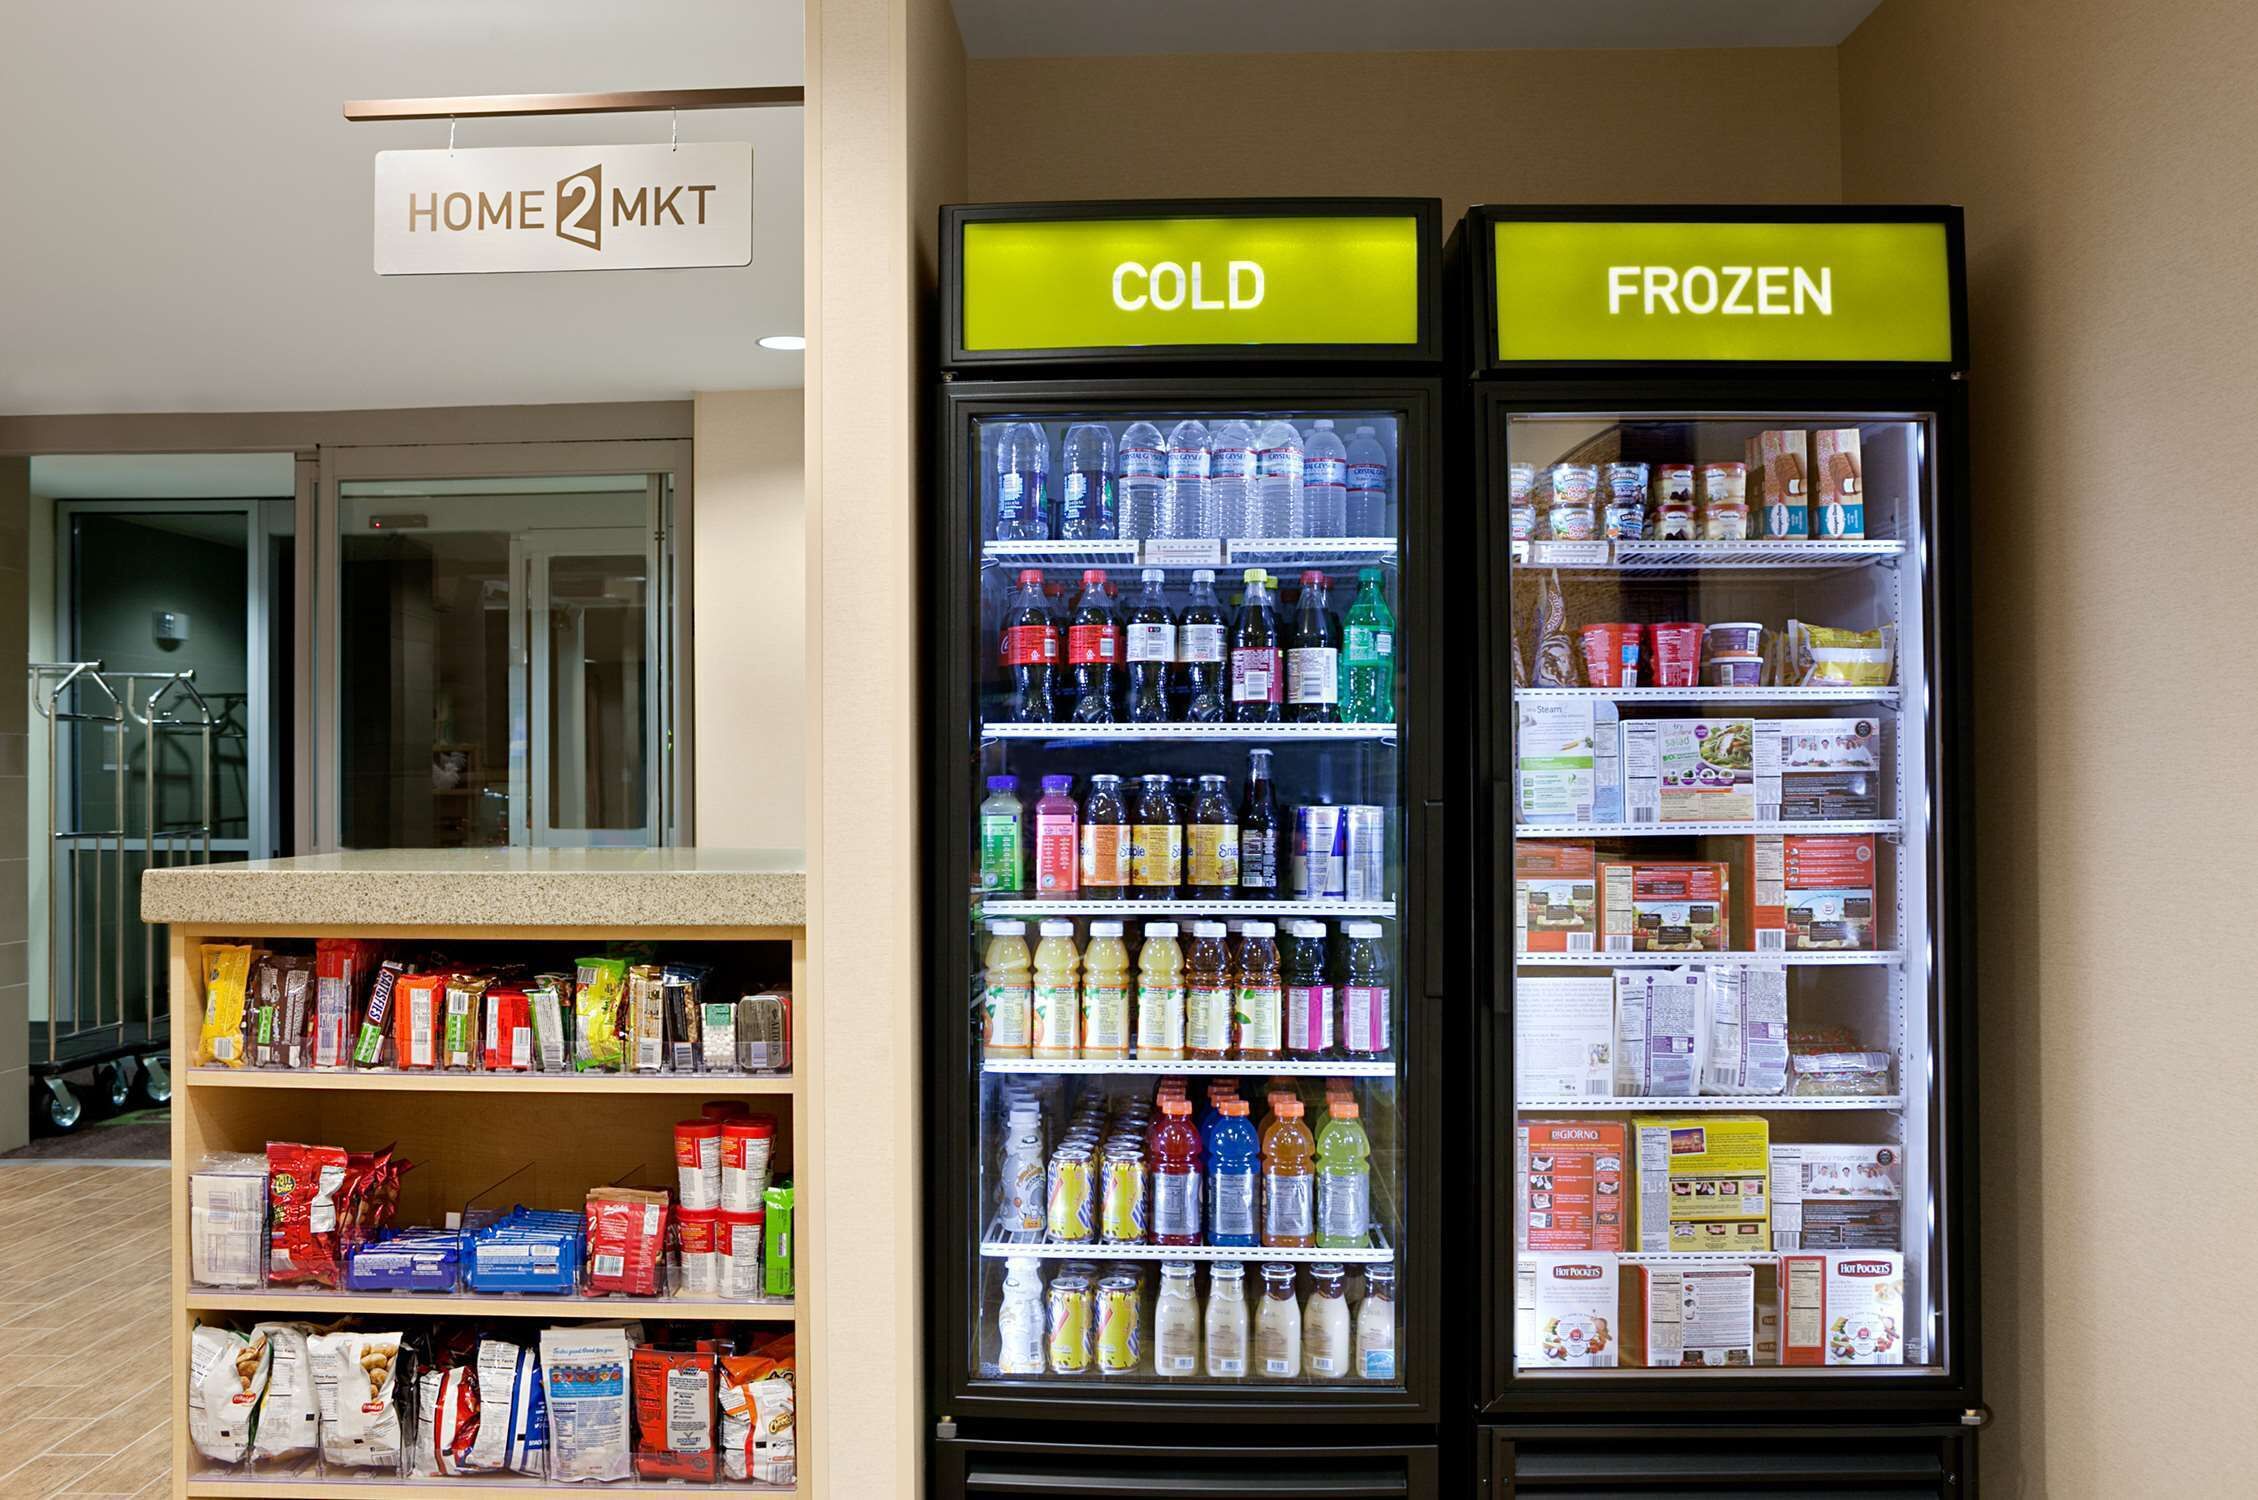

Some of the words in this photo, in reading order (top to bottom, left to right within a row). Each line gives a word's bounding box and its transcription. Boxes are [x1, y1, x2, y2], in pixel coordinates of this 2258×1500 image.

[1112, 261, 1265, 312] COLD
[1607, 265, 1833, 316] FROZEN
[1536, 705, 1562, 713] Steam
[369, 970, 394, 1022] SATISFIES
[1555, 1267, 1569, 1277] HOT
[1570, 1267, 1601, 1277] POCKETS
[1840, 1263, 1856, 1273] HOT
[1856, 1263, 1890, 1273] POCKETS
